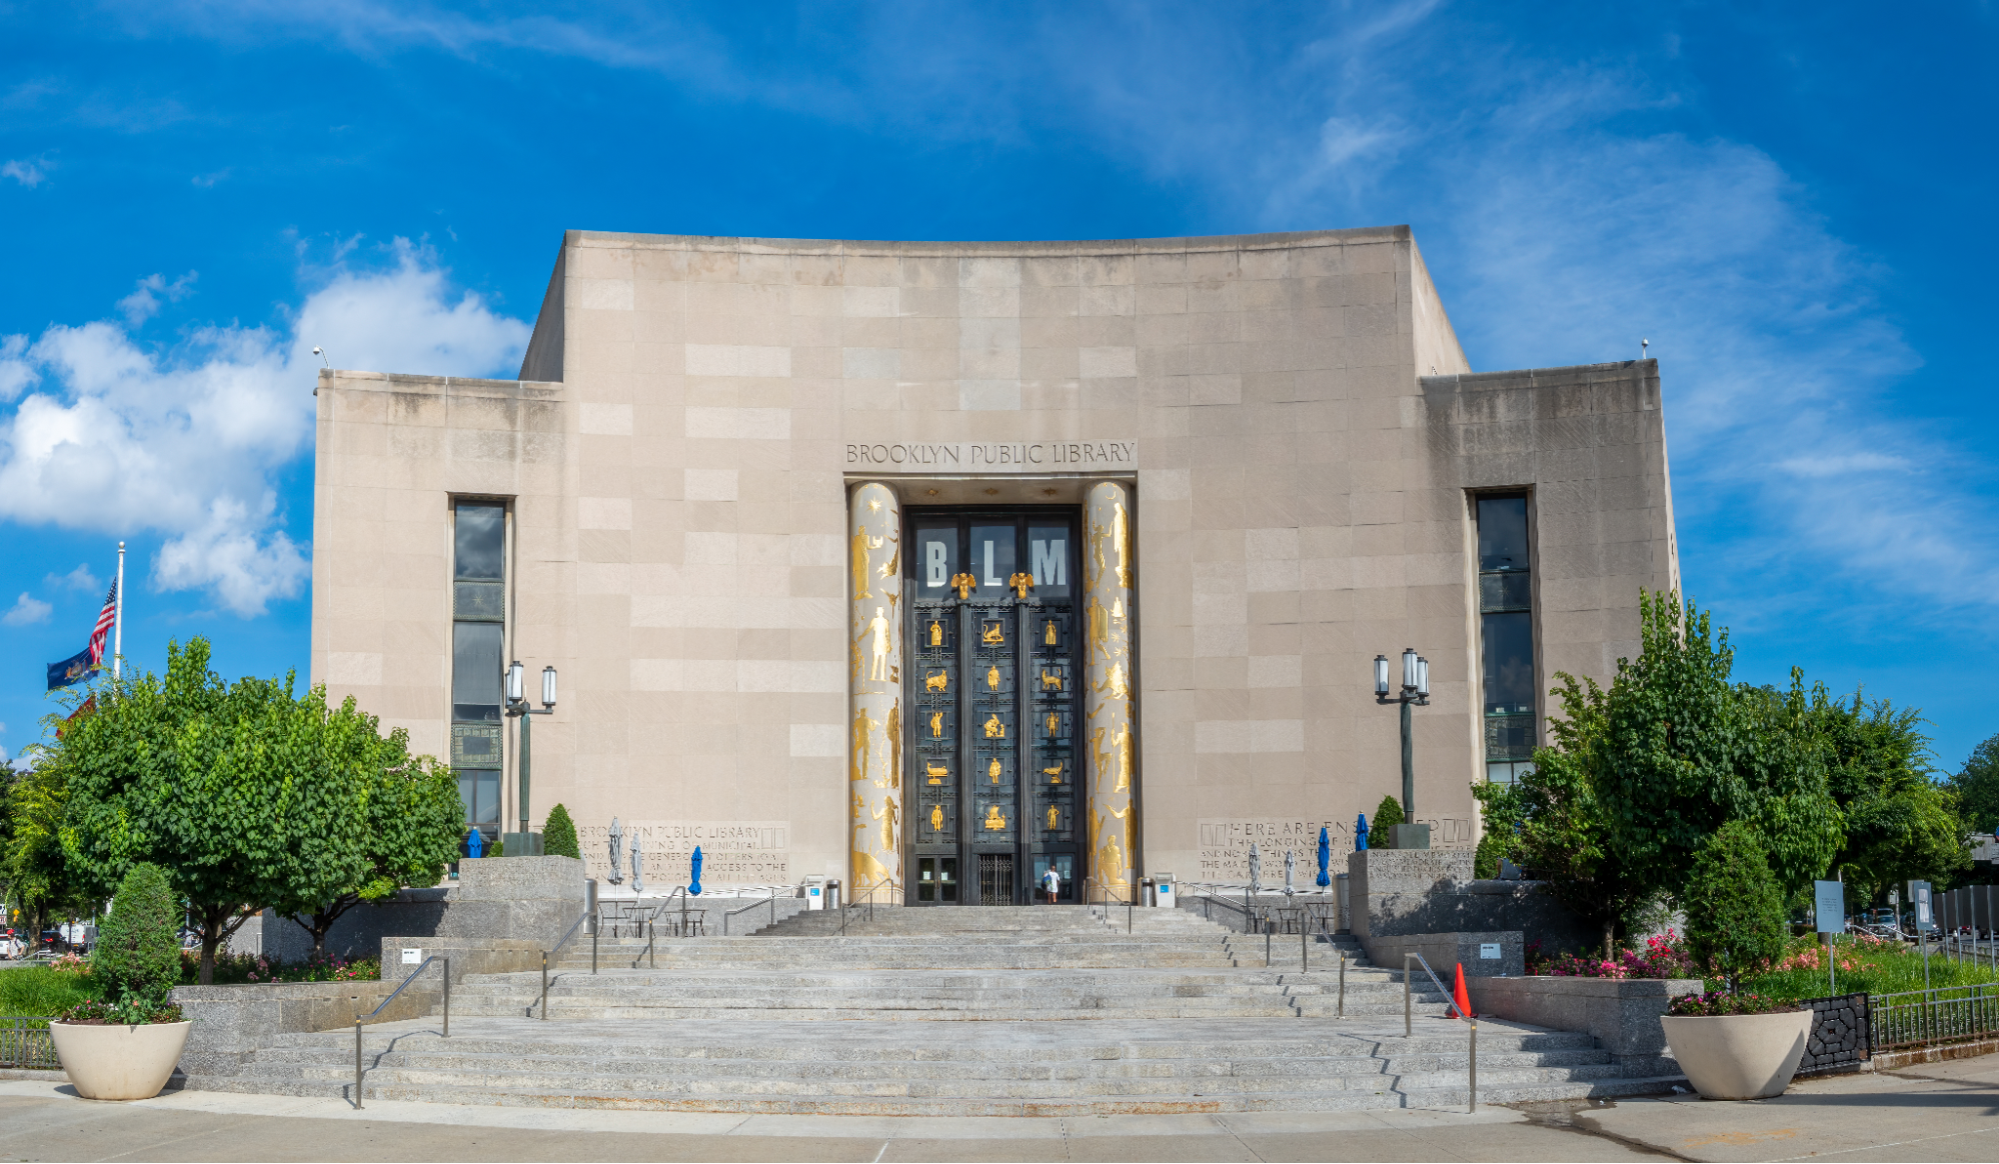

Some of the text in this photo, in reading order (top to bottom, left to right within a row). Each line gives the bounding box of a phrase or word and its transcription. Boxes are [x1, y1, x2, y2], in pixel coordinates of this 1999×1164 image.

[846, 442, 1136, 464] BROOKLYN PUBLIC LIBRARY
[926, 540, 1066, 587] B L M
[580, 826, 652, 838] BROKLYN
[709, 826, 761, 838] LIBRARY
[1229, 823, 1276, 836] HERE
[1282, 822, 1316, 835] ARE
[706, 863, 747, 872] ACCESS
[765, 863, 786, 872] THE
